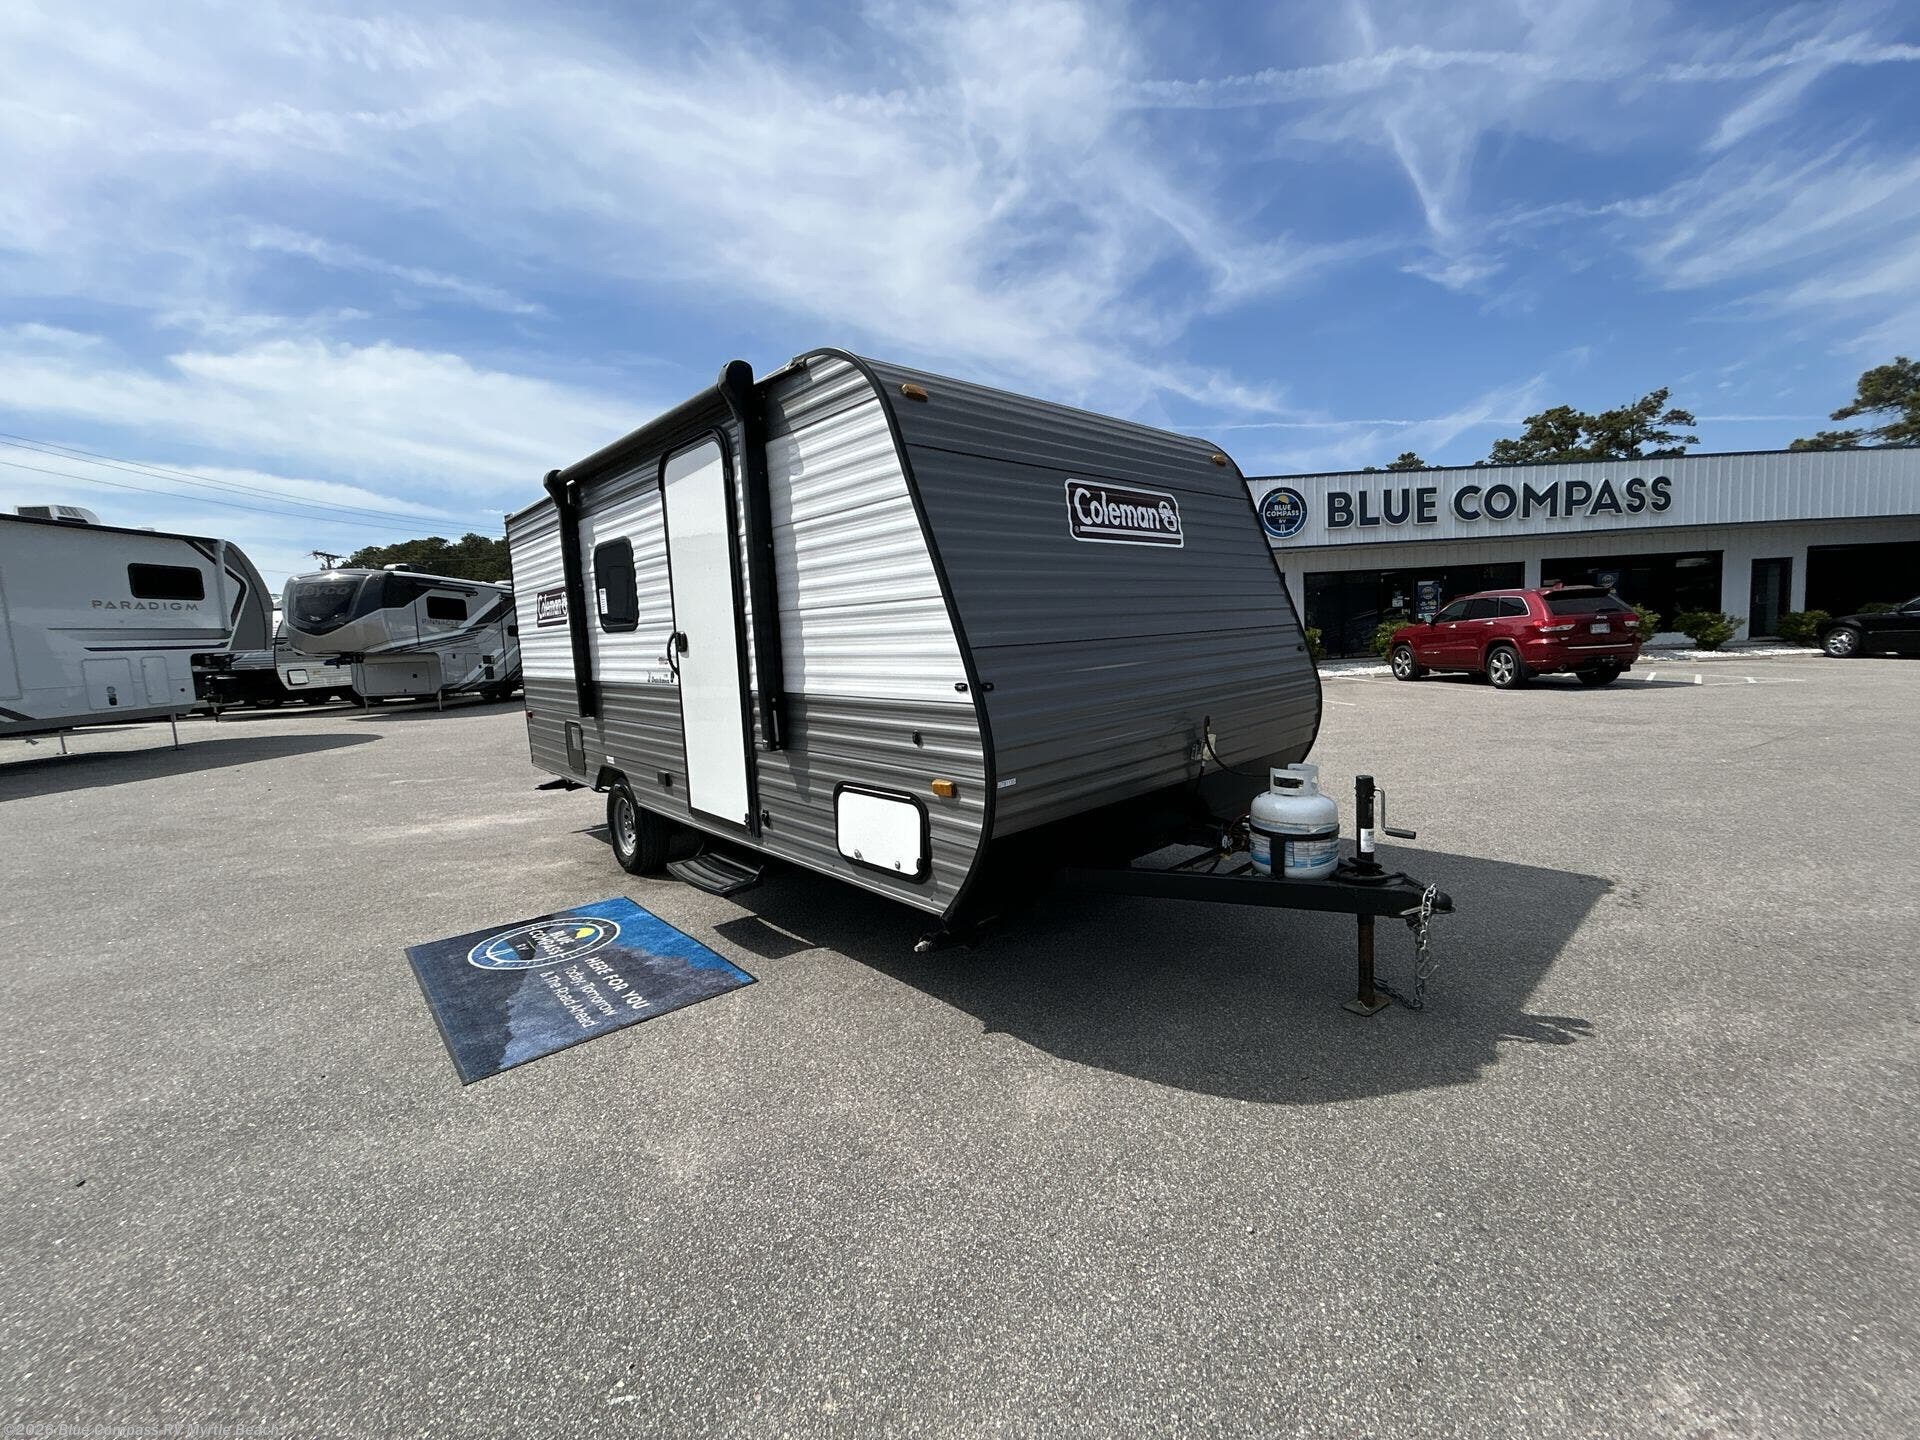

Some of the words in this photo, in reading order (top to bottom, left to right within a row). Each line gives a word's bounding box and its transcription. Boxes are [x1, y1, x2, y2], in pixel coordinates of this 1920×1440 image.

[1073, 487, 1160, 530] Coleman
[1327, 486, 1438, 528] BLUE
[1453, 476, 1673, 522] COMPASS
[91, 599, 199, 611] PARADIGM
[544, 975, 561, 988] The
[553, 986, 579, 1006] Road
[568, 1003, 600, 1029] Ahead
[580, 982, 618, 1016] Tomorrow
[584, 956, 614, 976] HERE
[603, 974, 629, 992] FOR
[621, 990, 651, 1010] YOU
